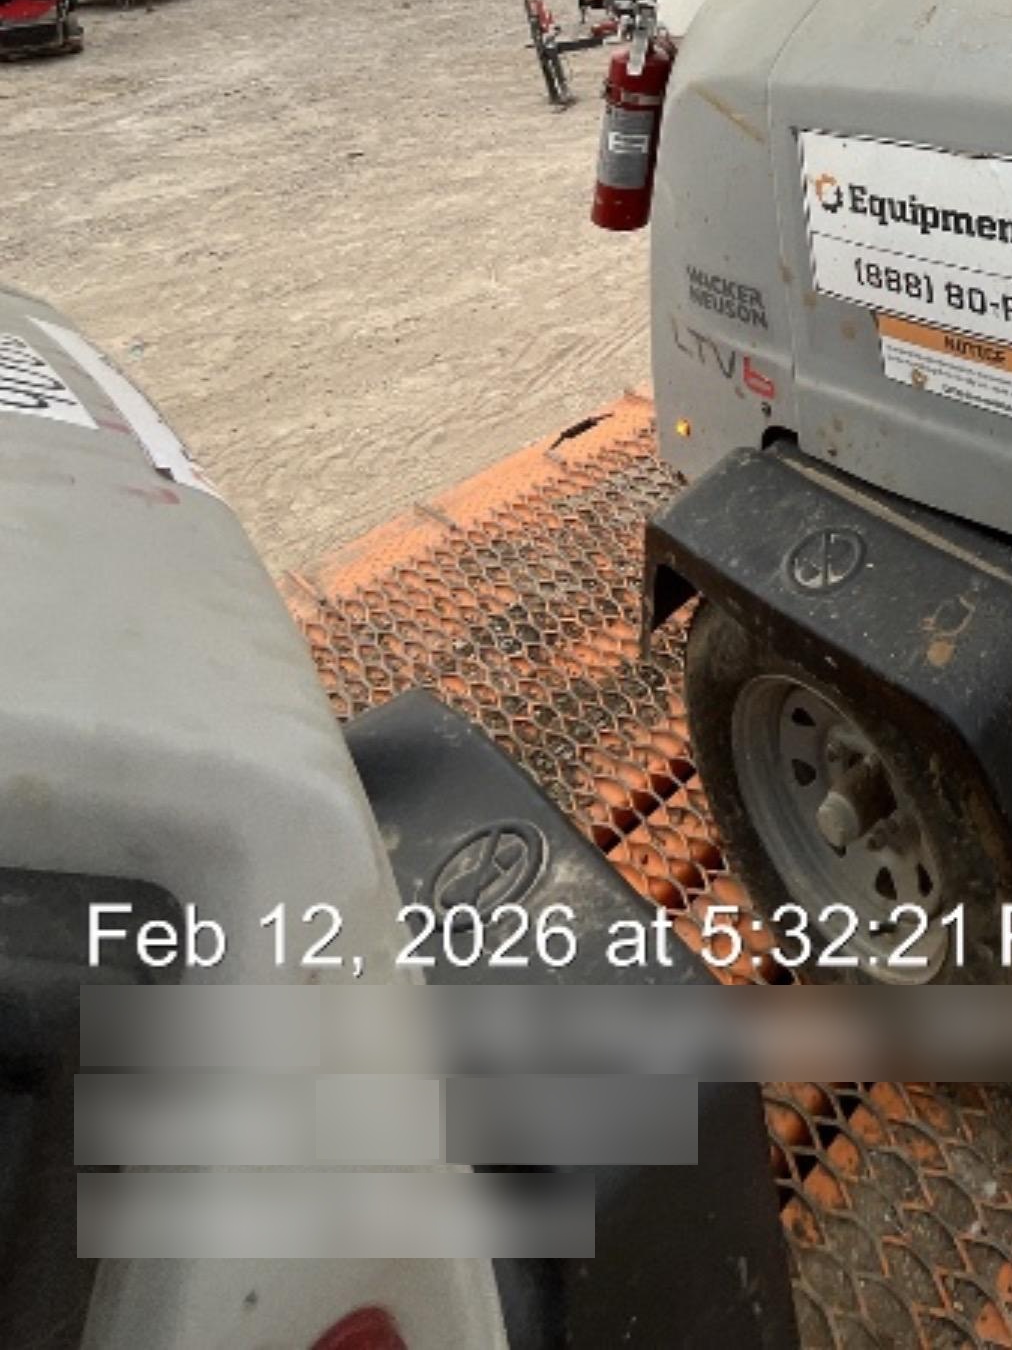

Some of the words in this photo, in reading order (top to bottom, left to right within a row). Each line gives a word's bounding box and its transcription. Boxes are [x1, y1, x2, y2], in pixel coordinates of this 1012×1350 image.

[686, 264, 766, 311] WACKER
[854, 256, 935, 304] (888)
[689, 284, 769, 331] NEUSON
